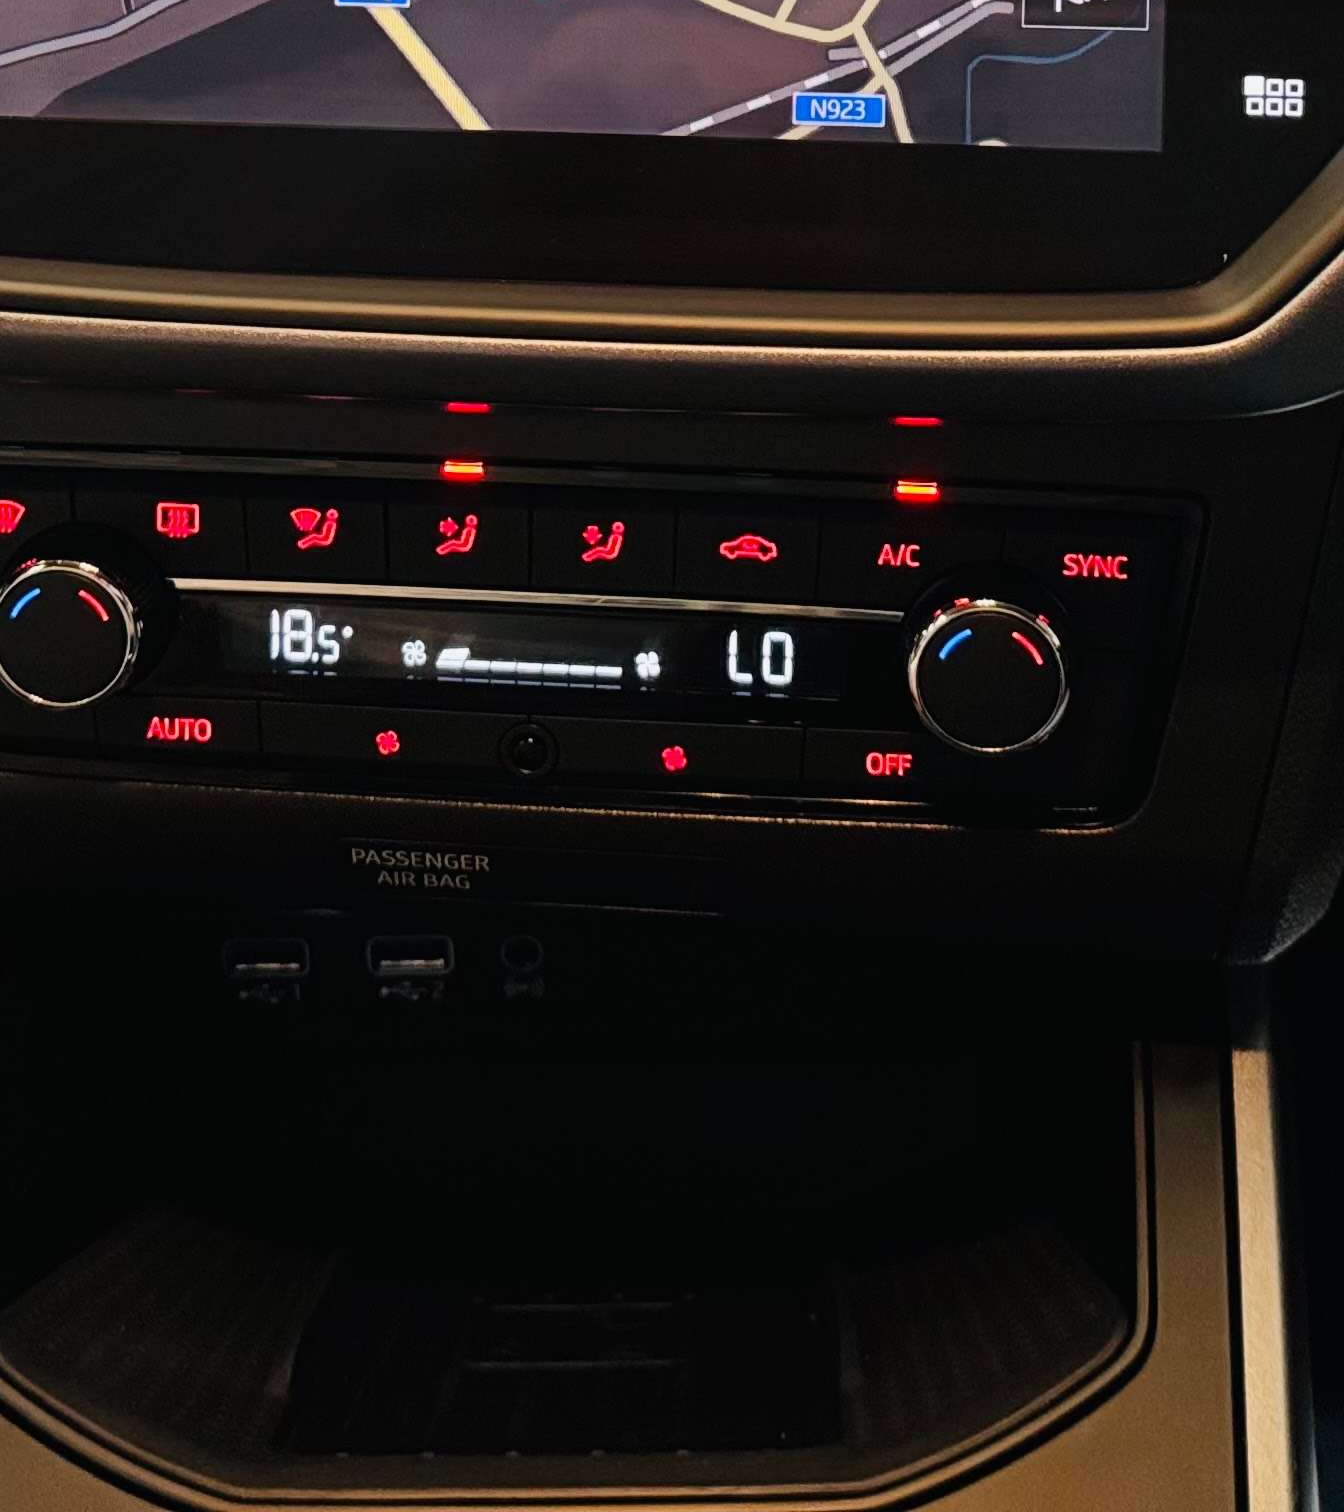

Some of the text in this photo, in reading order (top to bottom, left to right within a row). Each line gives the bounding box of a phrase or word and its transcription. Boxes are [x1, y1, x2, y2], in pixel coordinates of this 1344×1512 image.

[809, 99, 867, 122] N923
[877, 543, 921, 568] A/C
[1062, 553, 1130, 581] SYNC
[146, 716, 213, 743] AUTO
[865, 752, 913, 777] OFF
[350, 846, 491, 873] PASSENGER
[376, 871, 472, 891] AIR BAG
